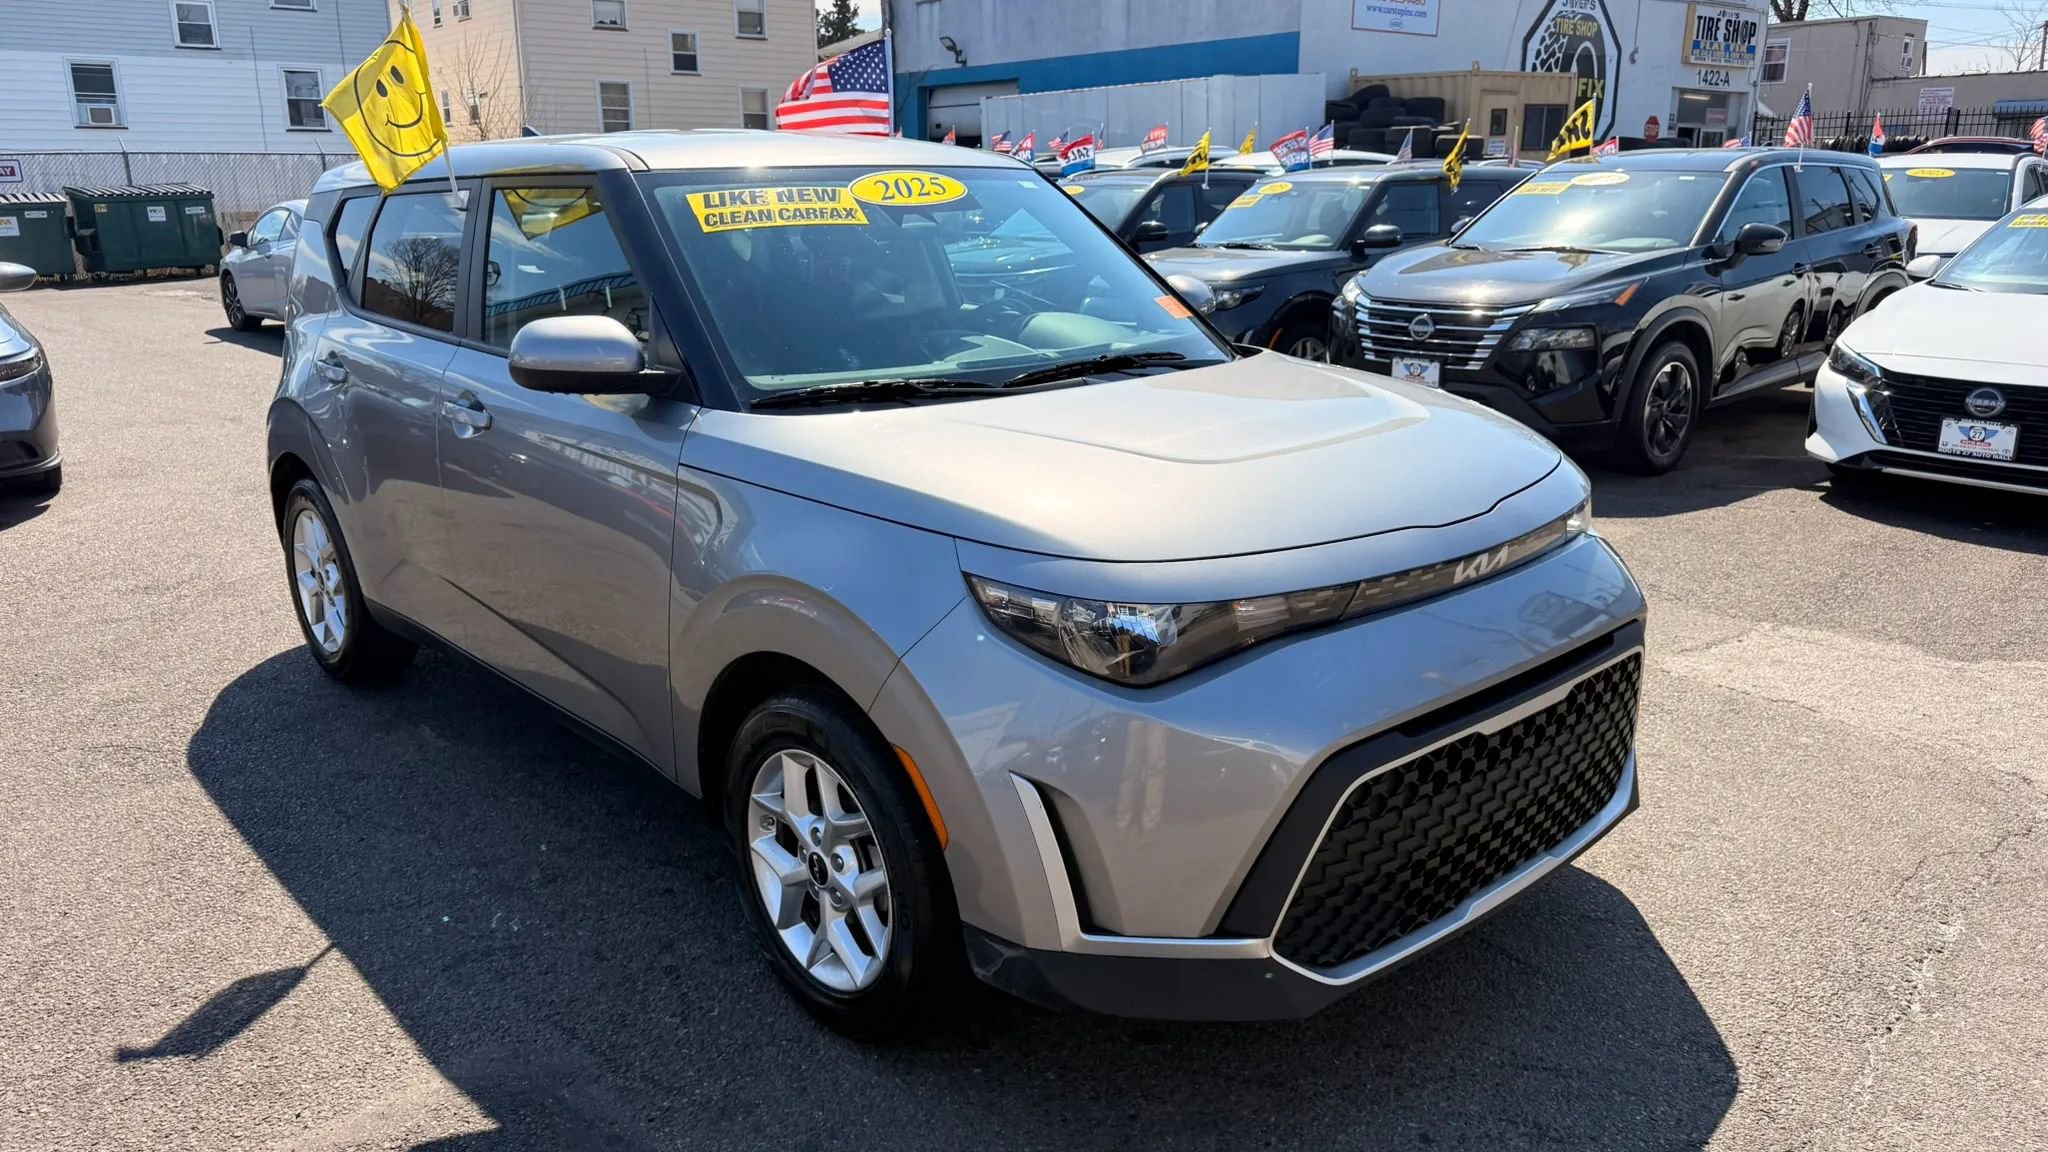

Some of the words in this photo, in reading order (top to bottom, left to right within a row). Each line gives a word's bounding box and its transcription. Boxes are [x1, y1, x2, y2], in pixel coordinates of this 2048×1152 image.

[1555, 17, 1574, 35] TIRE
[1575, 20, 1598, 37] SHOP
[1696, 15, 1721, 41] TIRE
[1723, 18, 1757, 45] SHOP
[1578, 77, 1605, 99] FIX
[1696, 69, 1730, 87] 1422-A
[703, 188, 767, 210] LIKE
[775, 187, 841, 205] NEW
[873, 176, 948, 202] 2025
[703, 208, 776, 228] CLEAN
[778, 207, 859, 222] CARFAX
[1965, 397, 2006, 408] NISSAN
[1971, 430, 1983, 440] 27
[1971, 451, 1991, 459] AUTO
[1993, 453, 2012, 461] MALL
[1453, 545, 1509, 585] KIA
